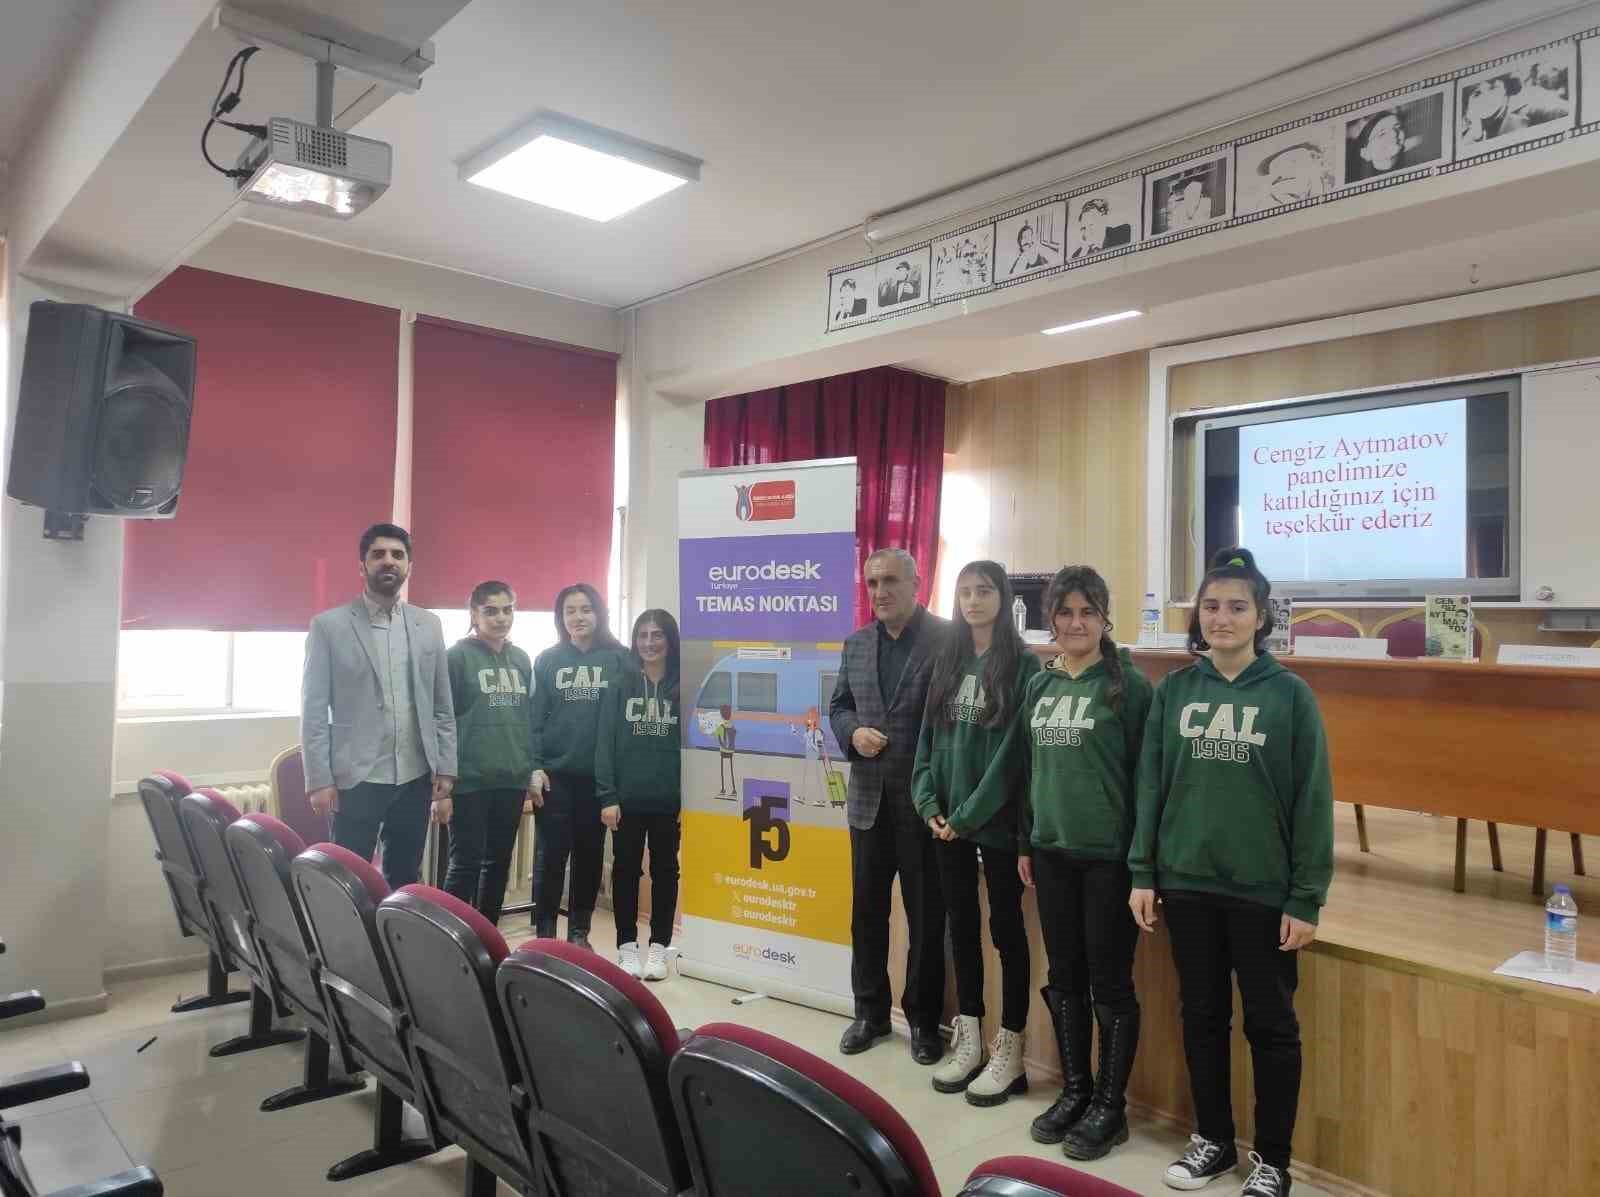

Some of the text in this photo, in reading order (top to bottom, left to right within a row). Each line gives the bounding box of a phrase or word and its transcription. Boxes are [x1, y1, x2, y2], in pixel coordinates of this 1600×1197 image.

[1253, 431, 1449, 466] Cengiz Aytmatov
[1287, 458, 1408, 491] panelimize
[1263, 481, 1435, 513] katıldığınız için
[1265, 506, 1433, 539] teşekkür ederiz
[708, 559, 822, 581] eurodesk
[696, 595, 838, 613] TEMAS NOKTASI
[478, 667, 527, 694] CAL
[555, 665, 609, 690] CAL
[625, 696, 678, 724] CAL
[1031, 695, 1095, 730] CAL
[1037, 727, 1081, 746] 1996
[1180, 702, 1267, 746] CAL
[1191, 738, 1250, 763] 1996
[733, 943, 796, 965] eurodesk
